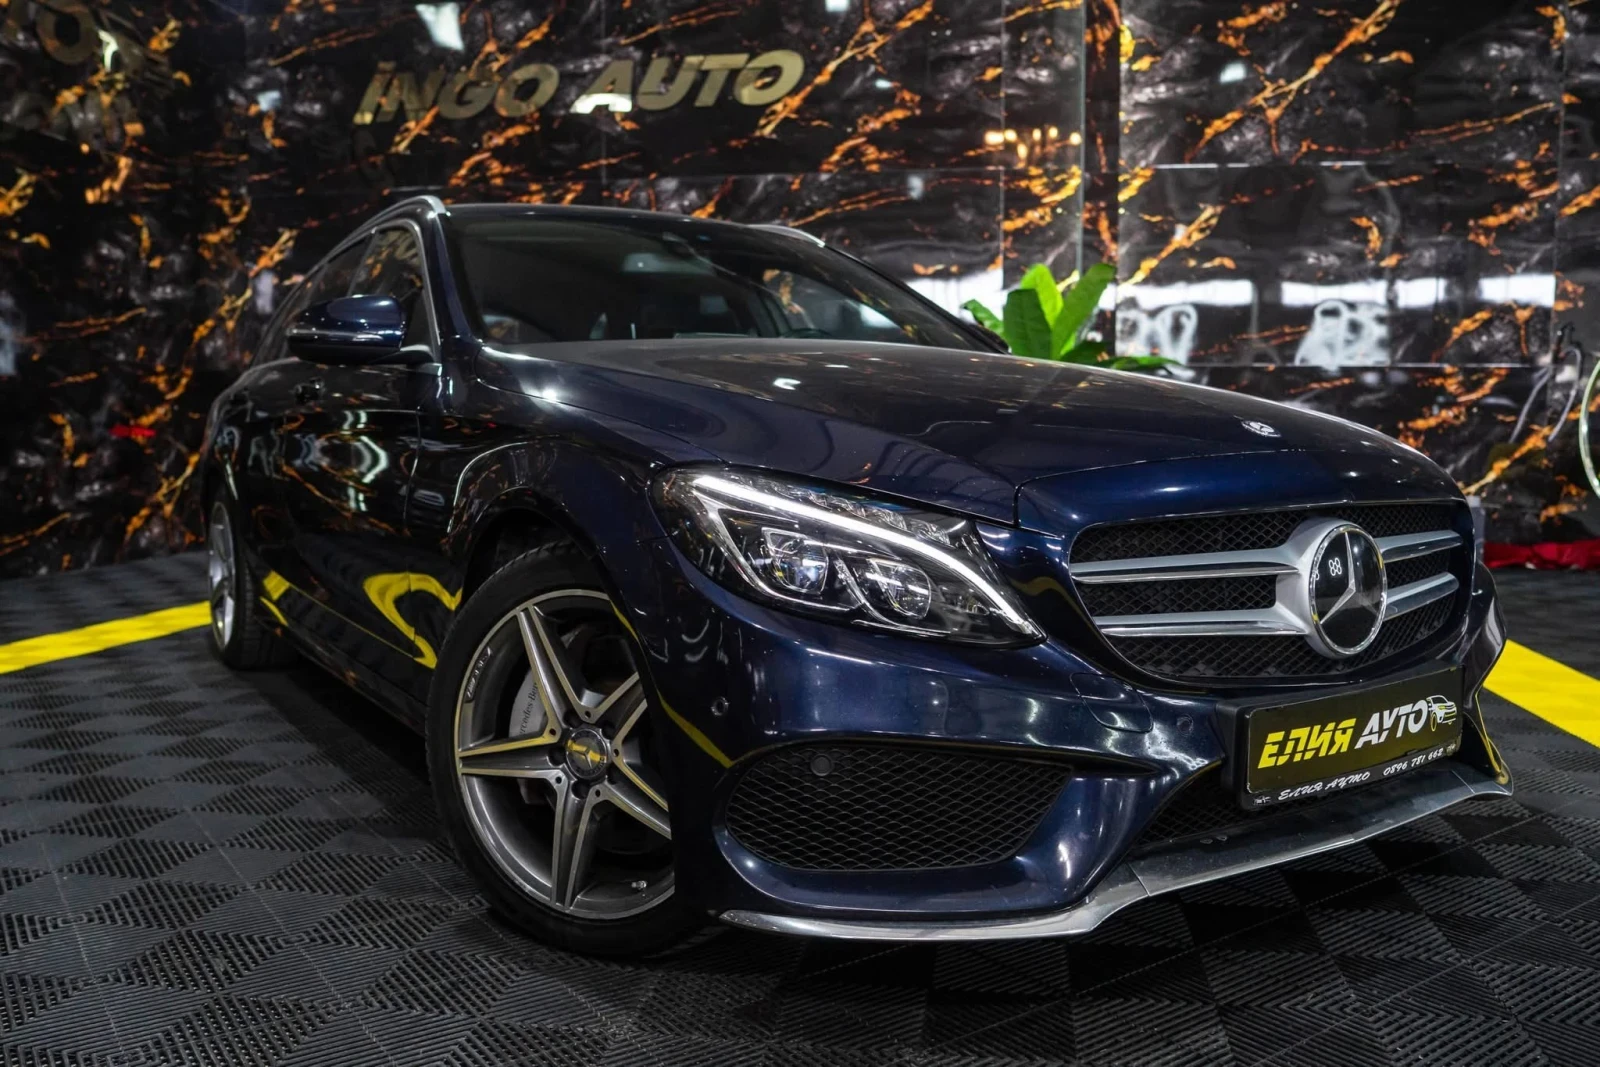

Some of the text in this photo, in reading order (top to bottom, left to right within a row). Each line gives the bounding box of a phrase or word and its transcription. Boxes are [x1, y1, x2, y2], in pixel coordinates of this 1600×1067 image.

[569, 49, 805, 114] AUTO
[1257, 700, 1428, 769] ЕЛИЯ АУТО
[1382, 760, 1409, 776] 0896
[1410, 754, 1428, 768] 781
